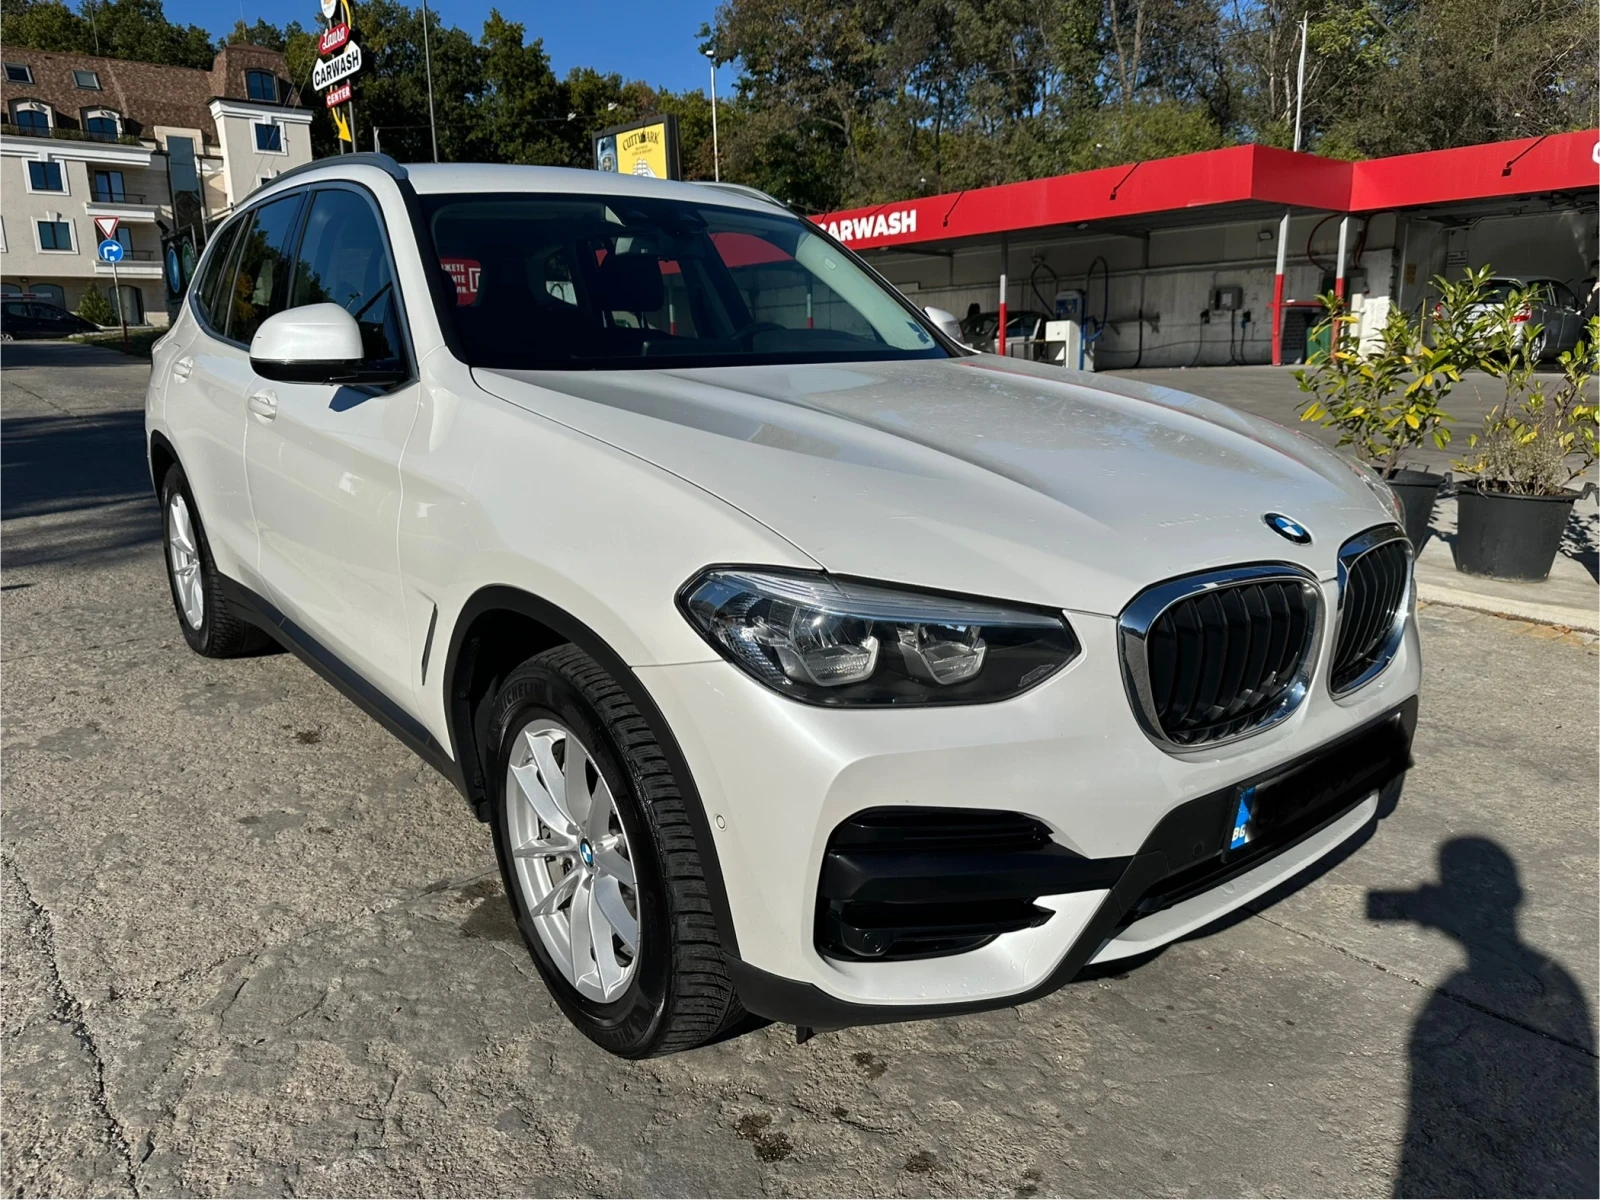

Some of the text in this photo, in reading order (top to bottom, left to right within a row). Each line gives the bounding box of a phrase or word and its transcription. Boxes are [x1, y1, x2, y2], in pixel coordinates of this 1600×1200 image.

[314, 49, 359, 86] CARWASH
[326, 86, 351, 106] CENTER
[643, 130, 661, 144] ARK
[440, 263, 465, 272] ЖЕТЕ
[1232, 824, 1246, 841] BG
